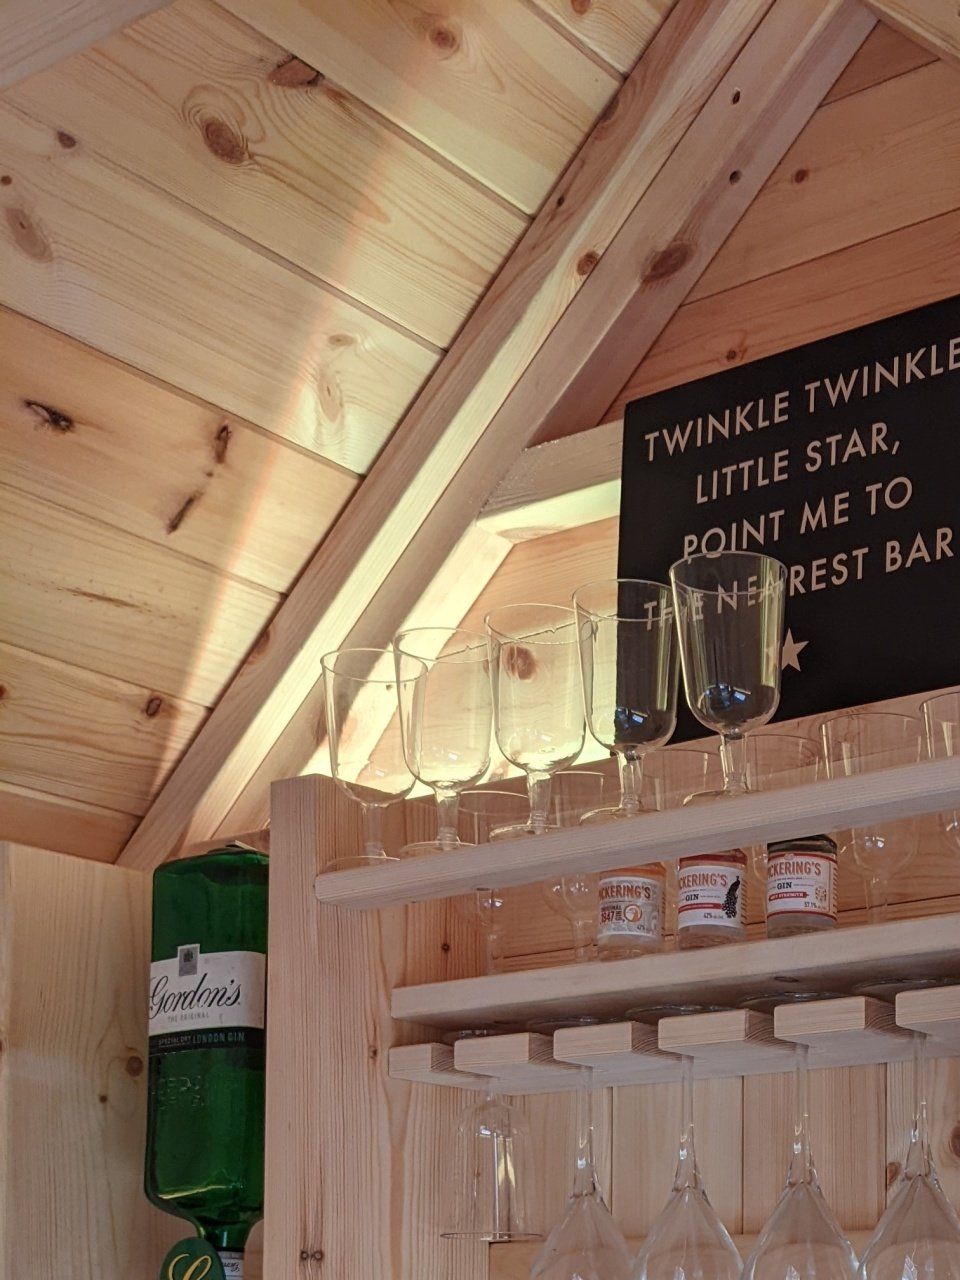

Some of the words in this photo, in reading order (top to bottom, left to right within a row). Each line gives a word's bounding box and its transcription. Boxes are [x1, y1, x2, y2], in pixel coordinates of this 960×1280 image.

[645, 391, 789, 461] TWINKLE
[697, 450, 788, 504] LITTLE
[805, 422, 900, 474] STAR,
[683, 509, 785, 564] POINT
[800, 492, 849, 535] ME
[866, 477, 912, 515] TO
[885, 527, 954, 573] BAR
[679, 873, 727, 890] CKERING'S
[768, 861, 821, 878] ICKERING'S
[685, 894, 699, 902] GIN
[777, 881, 792, 890] GIN
[149, 973, 242, 1019] Gordon's
[228, 1032, 245, 1040] GIN
